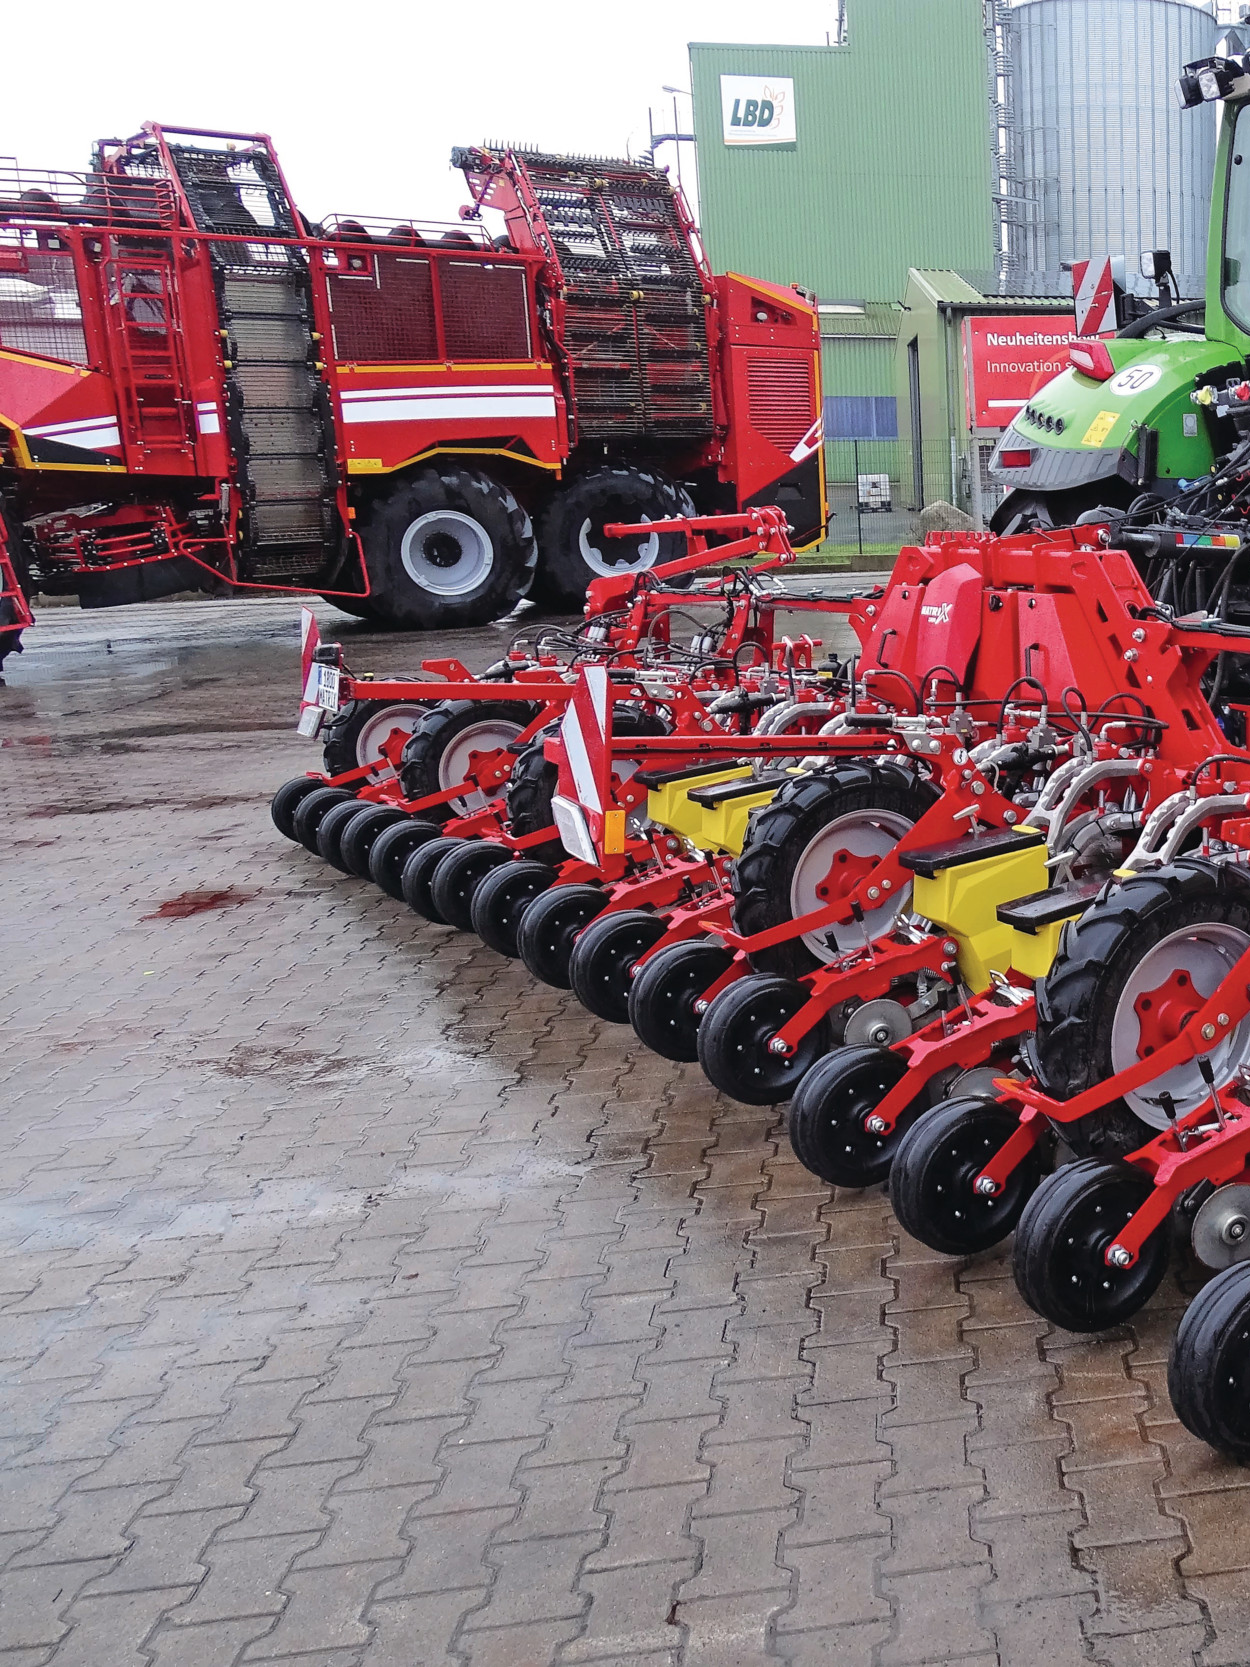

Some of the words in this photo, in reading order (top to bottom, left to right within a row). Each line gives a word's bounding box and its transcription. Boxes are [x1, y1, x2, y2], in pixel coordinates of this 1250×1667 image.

[730, 98, 775, 128] LBD
[986, 332, 1100, 346] Neuheitenshw
[987, 360, 1061, 373] Innovation
[1117, 369, 1154, 389] 50
